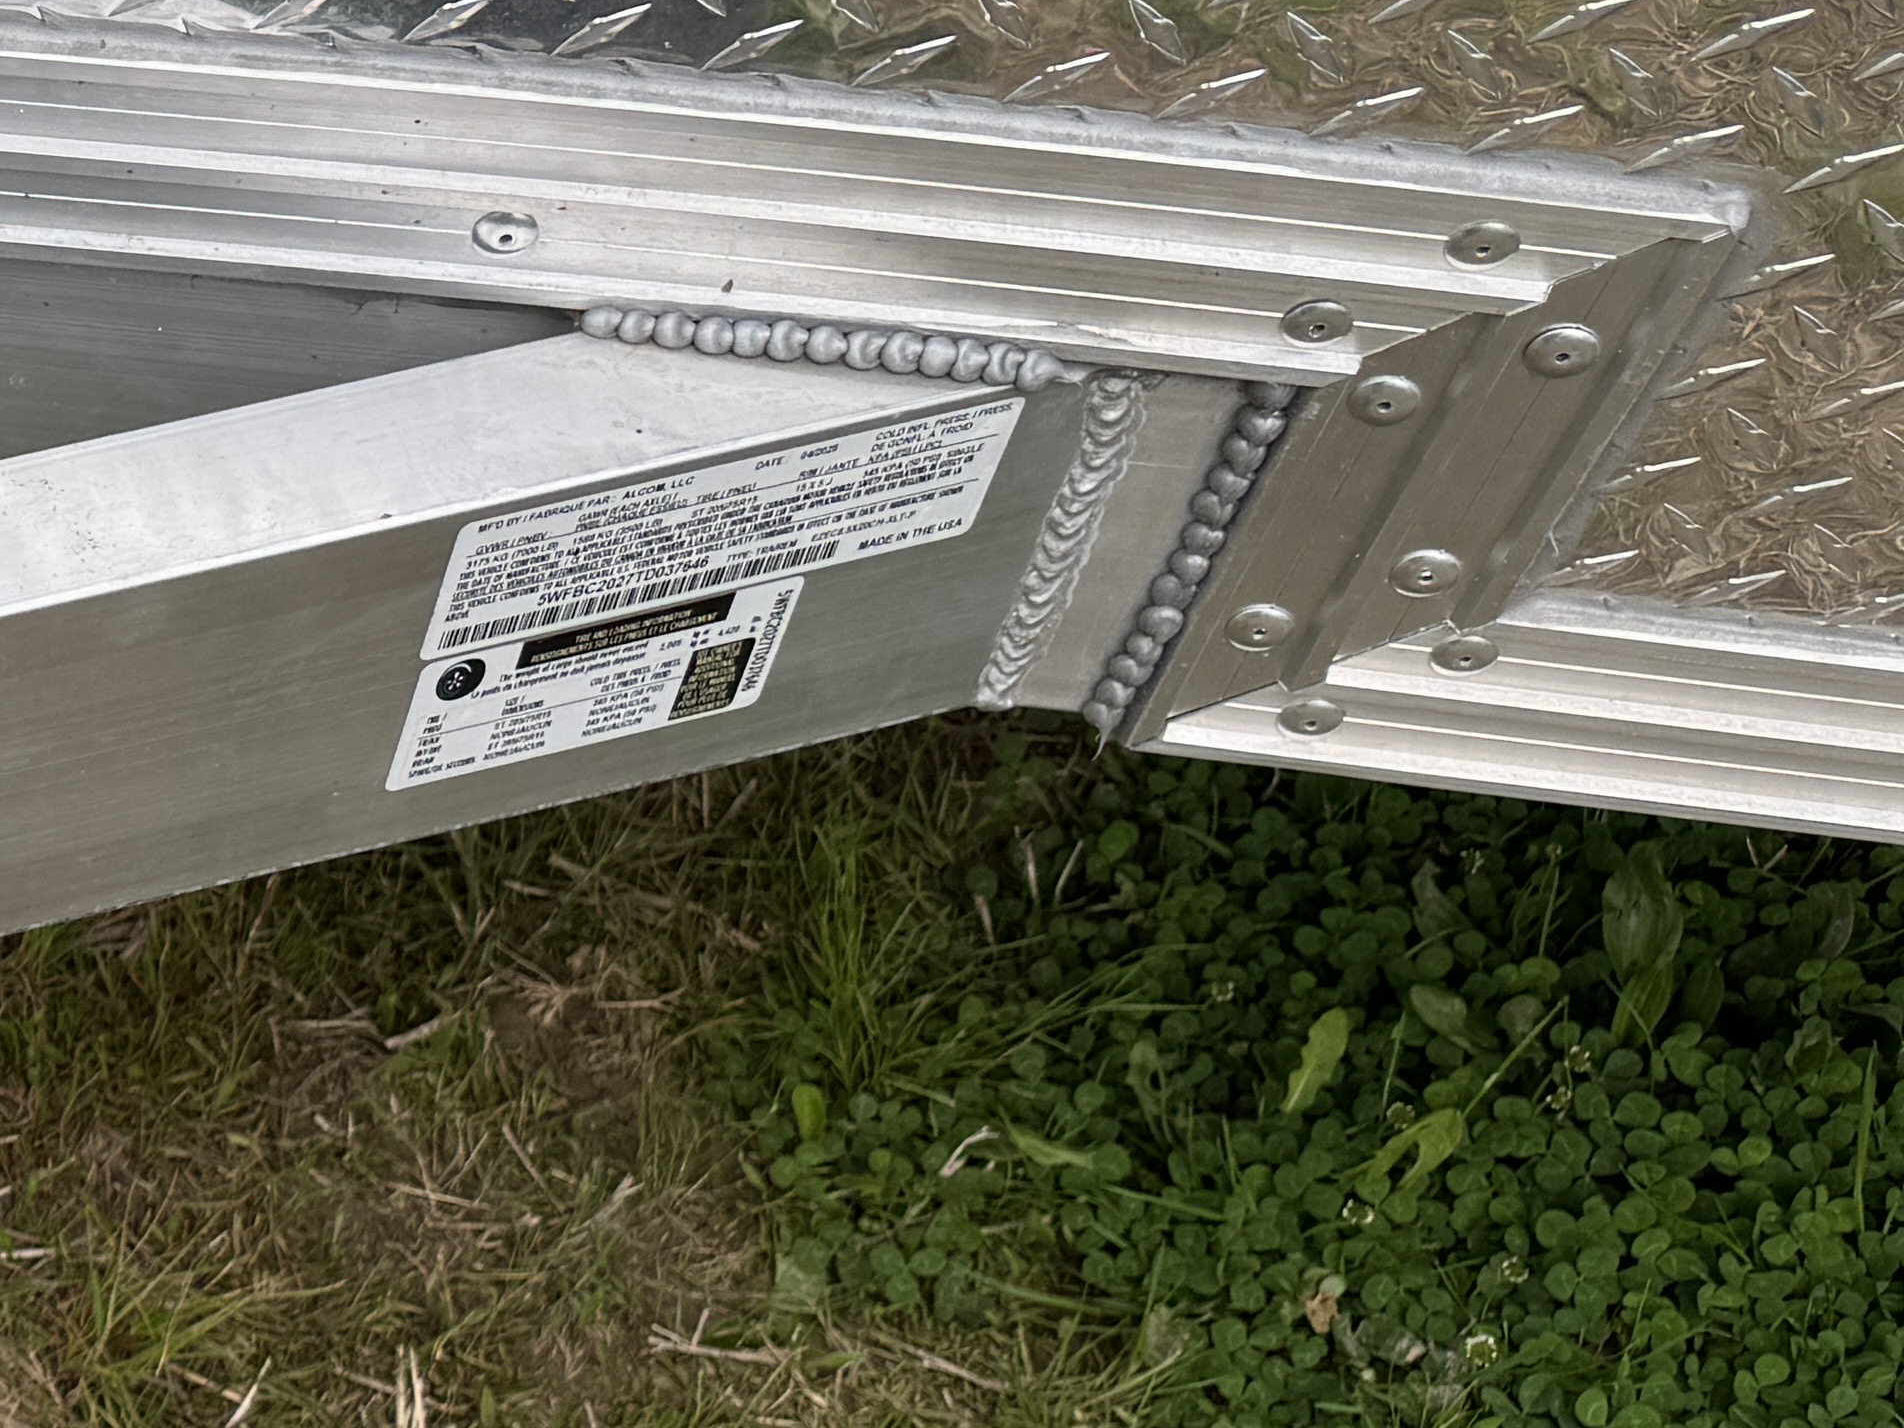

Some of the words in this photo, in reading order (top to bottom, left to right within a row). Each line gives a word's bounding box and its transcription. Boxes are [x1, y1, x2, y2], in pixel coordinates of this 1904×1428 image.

[874, 426, 906, 441] COLD
[870, 441, 885, 452] DE
[944, 442, 985, 459] SINGLE
[823, 458, 859, 475] JANTE
[505, 514, 522, 527] BY
[521, 513, 528, 523] /
[669, 475, 695, 489] LLC
[690, 507, 705, 518] ST
[856, 532, 895, 550] MADE
[894, 529, 910, 541] IN
[910, 523, 937, 538] THE
[936, 517, 964, 532] USA
[465, 556, 491, 570] 3175
[491, 552, 509, 564] KG
[536, 554, 711, 606] 5WFBC2027TD037646
